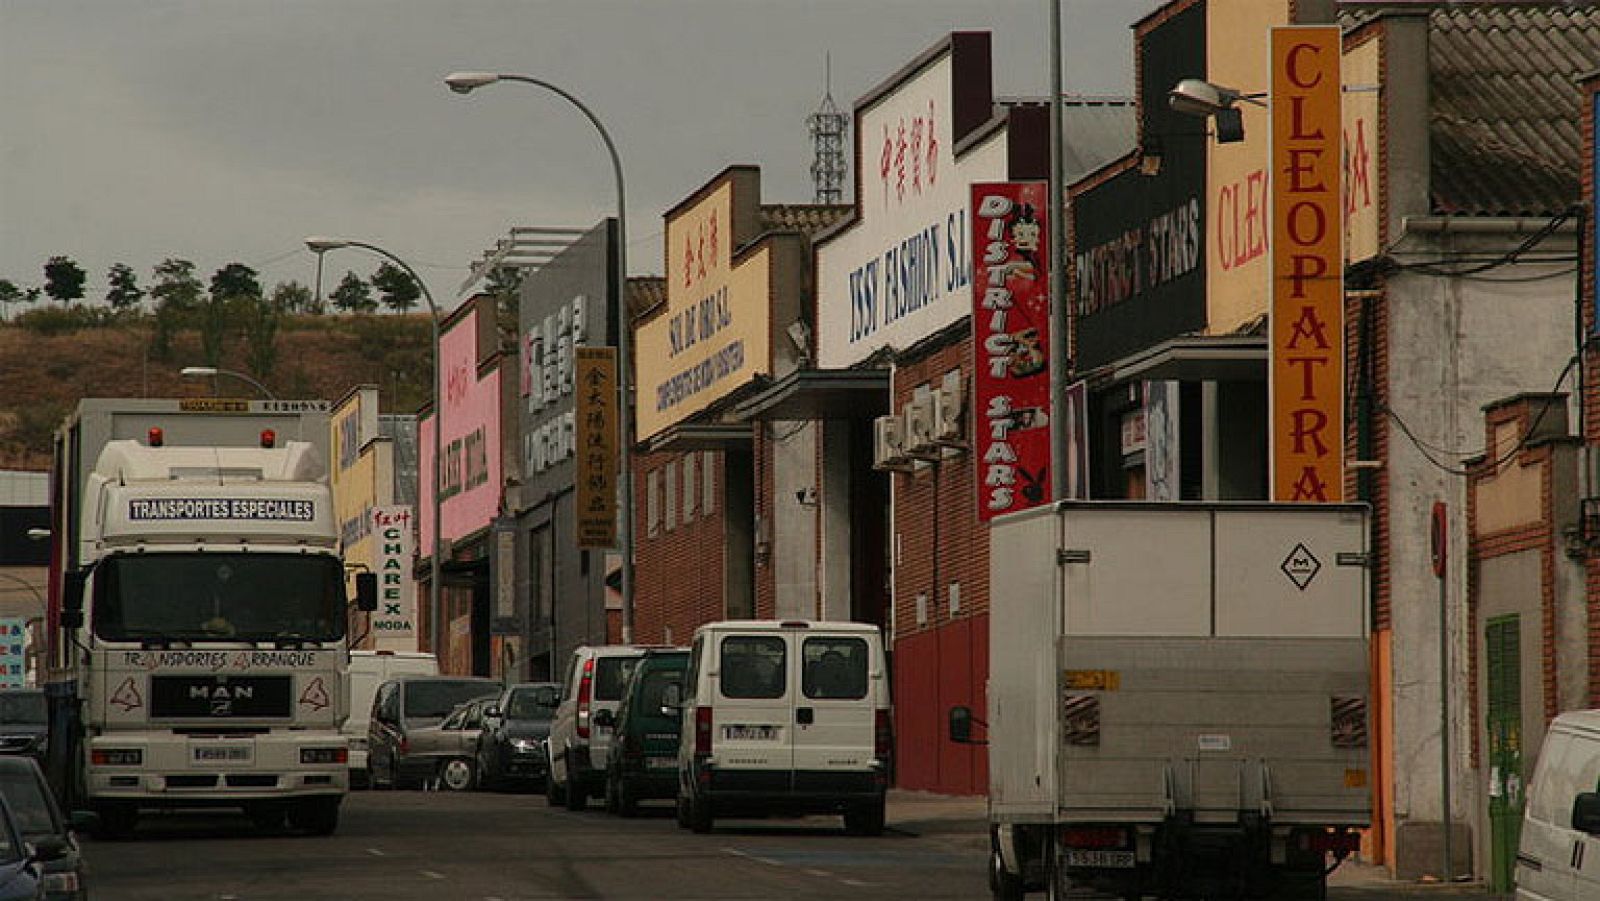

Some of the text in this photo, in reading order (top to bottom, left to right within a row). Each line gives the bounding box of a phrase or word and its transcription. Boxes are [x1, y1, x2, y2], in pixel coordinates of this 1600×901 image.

[885, 223, 940, 325] FASHION
[1149, 194, 1200, 288] STARS
[1285, 43, 1329, 500] CLEOPATRA
[978, 195, 1018, 510] DISTRICT STARS
[131, 500, 313, 520] TRANSPORTES ESPECIALES
[384, 528, 401, 615] CHAREX
[374, 620, 411, 631] MODA
[189, 685, 253, 699] MAN
